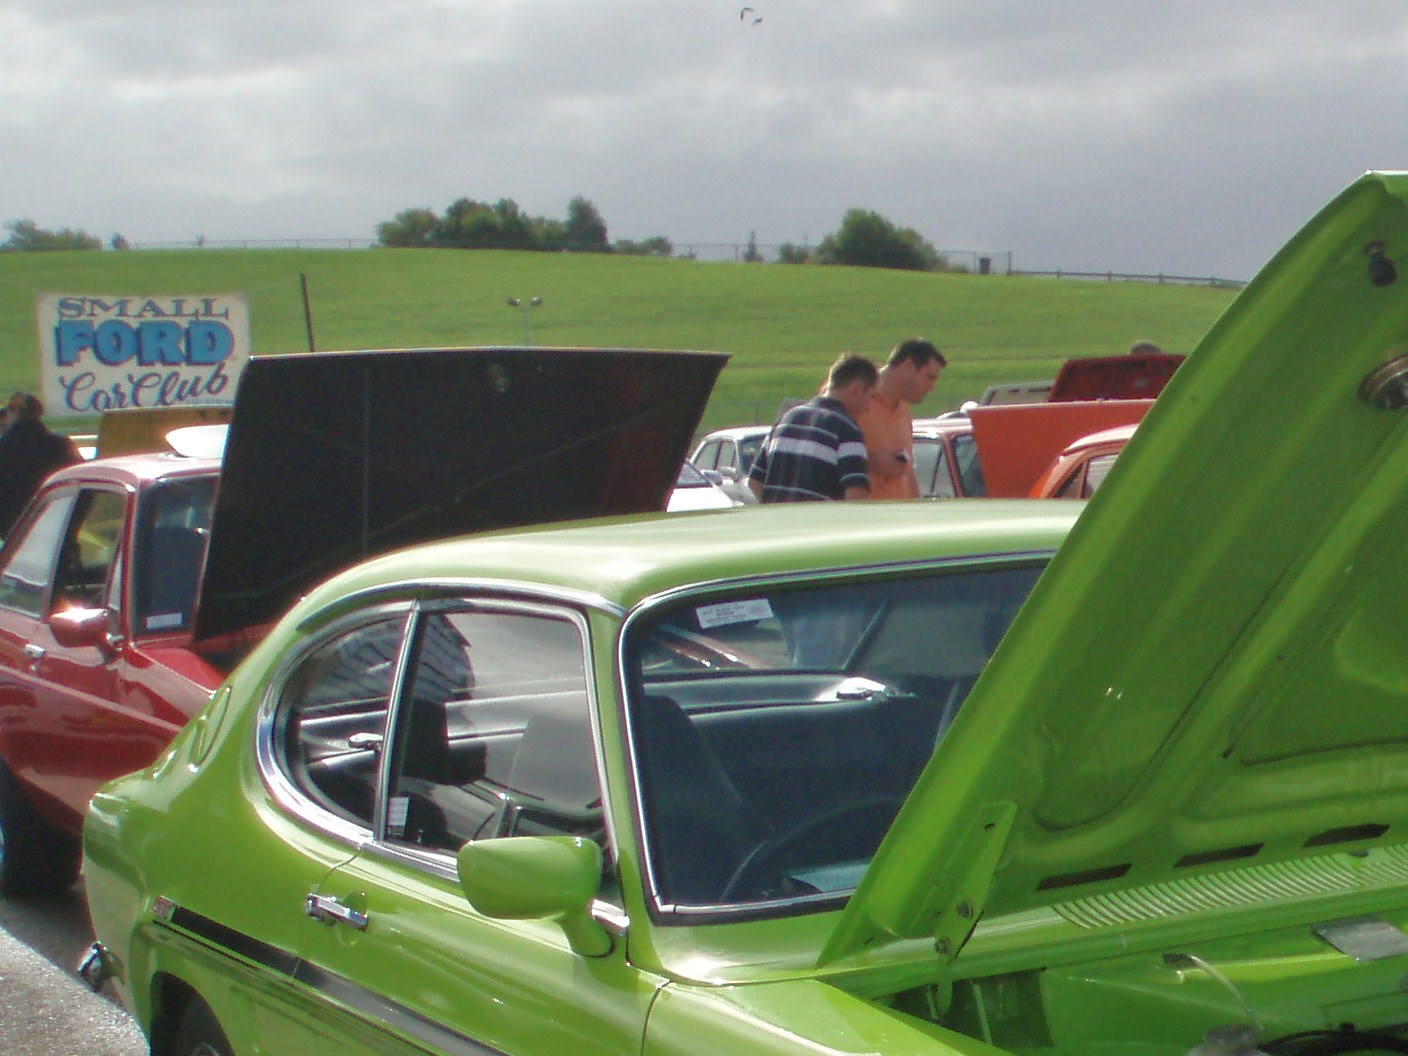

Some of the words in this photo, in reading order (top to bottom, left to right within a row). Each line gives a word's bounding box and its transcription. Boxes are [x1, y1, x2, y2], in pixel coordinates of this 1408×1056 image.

[58, 296, 229, 319] SMALL
[54, 319, 234, 366] FORD
[58, 371, 127, 411] Car
[127, 362, 230, 407] Club
